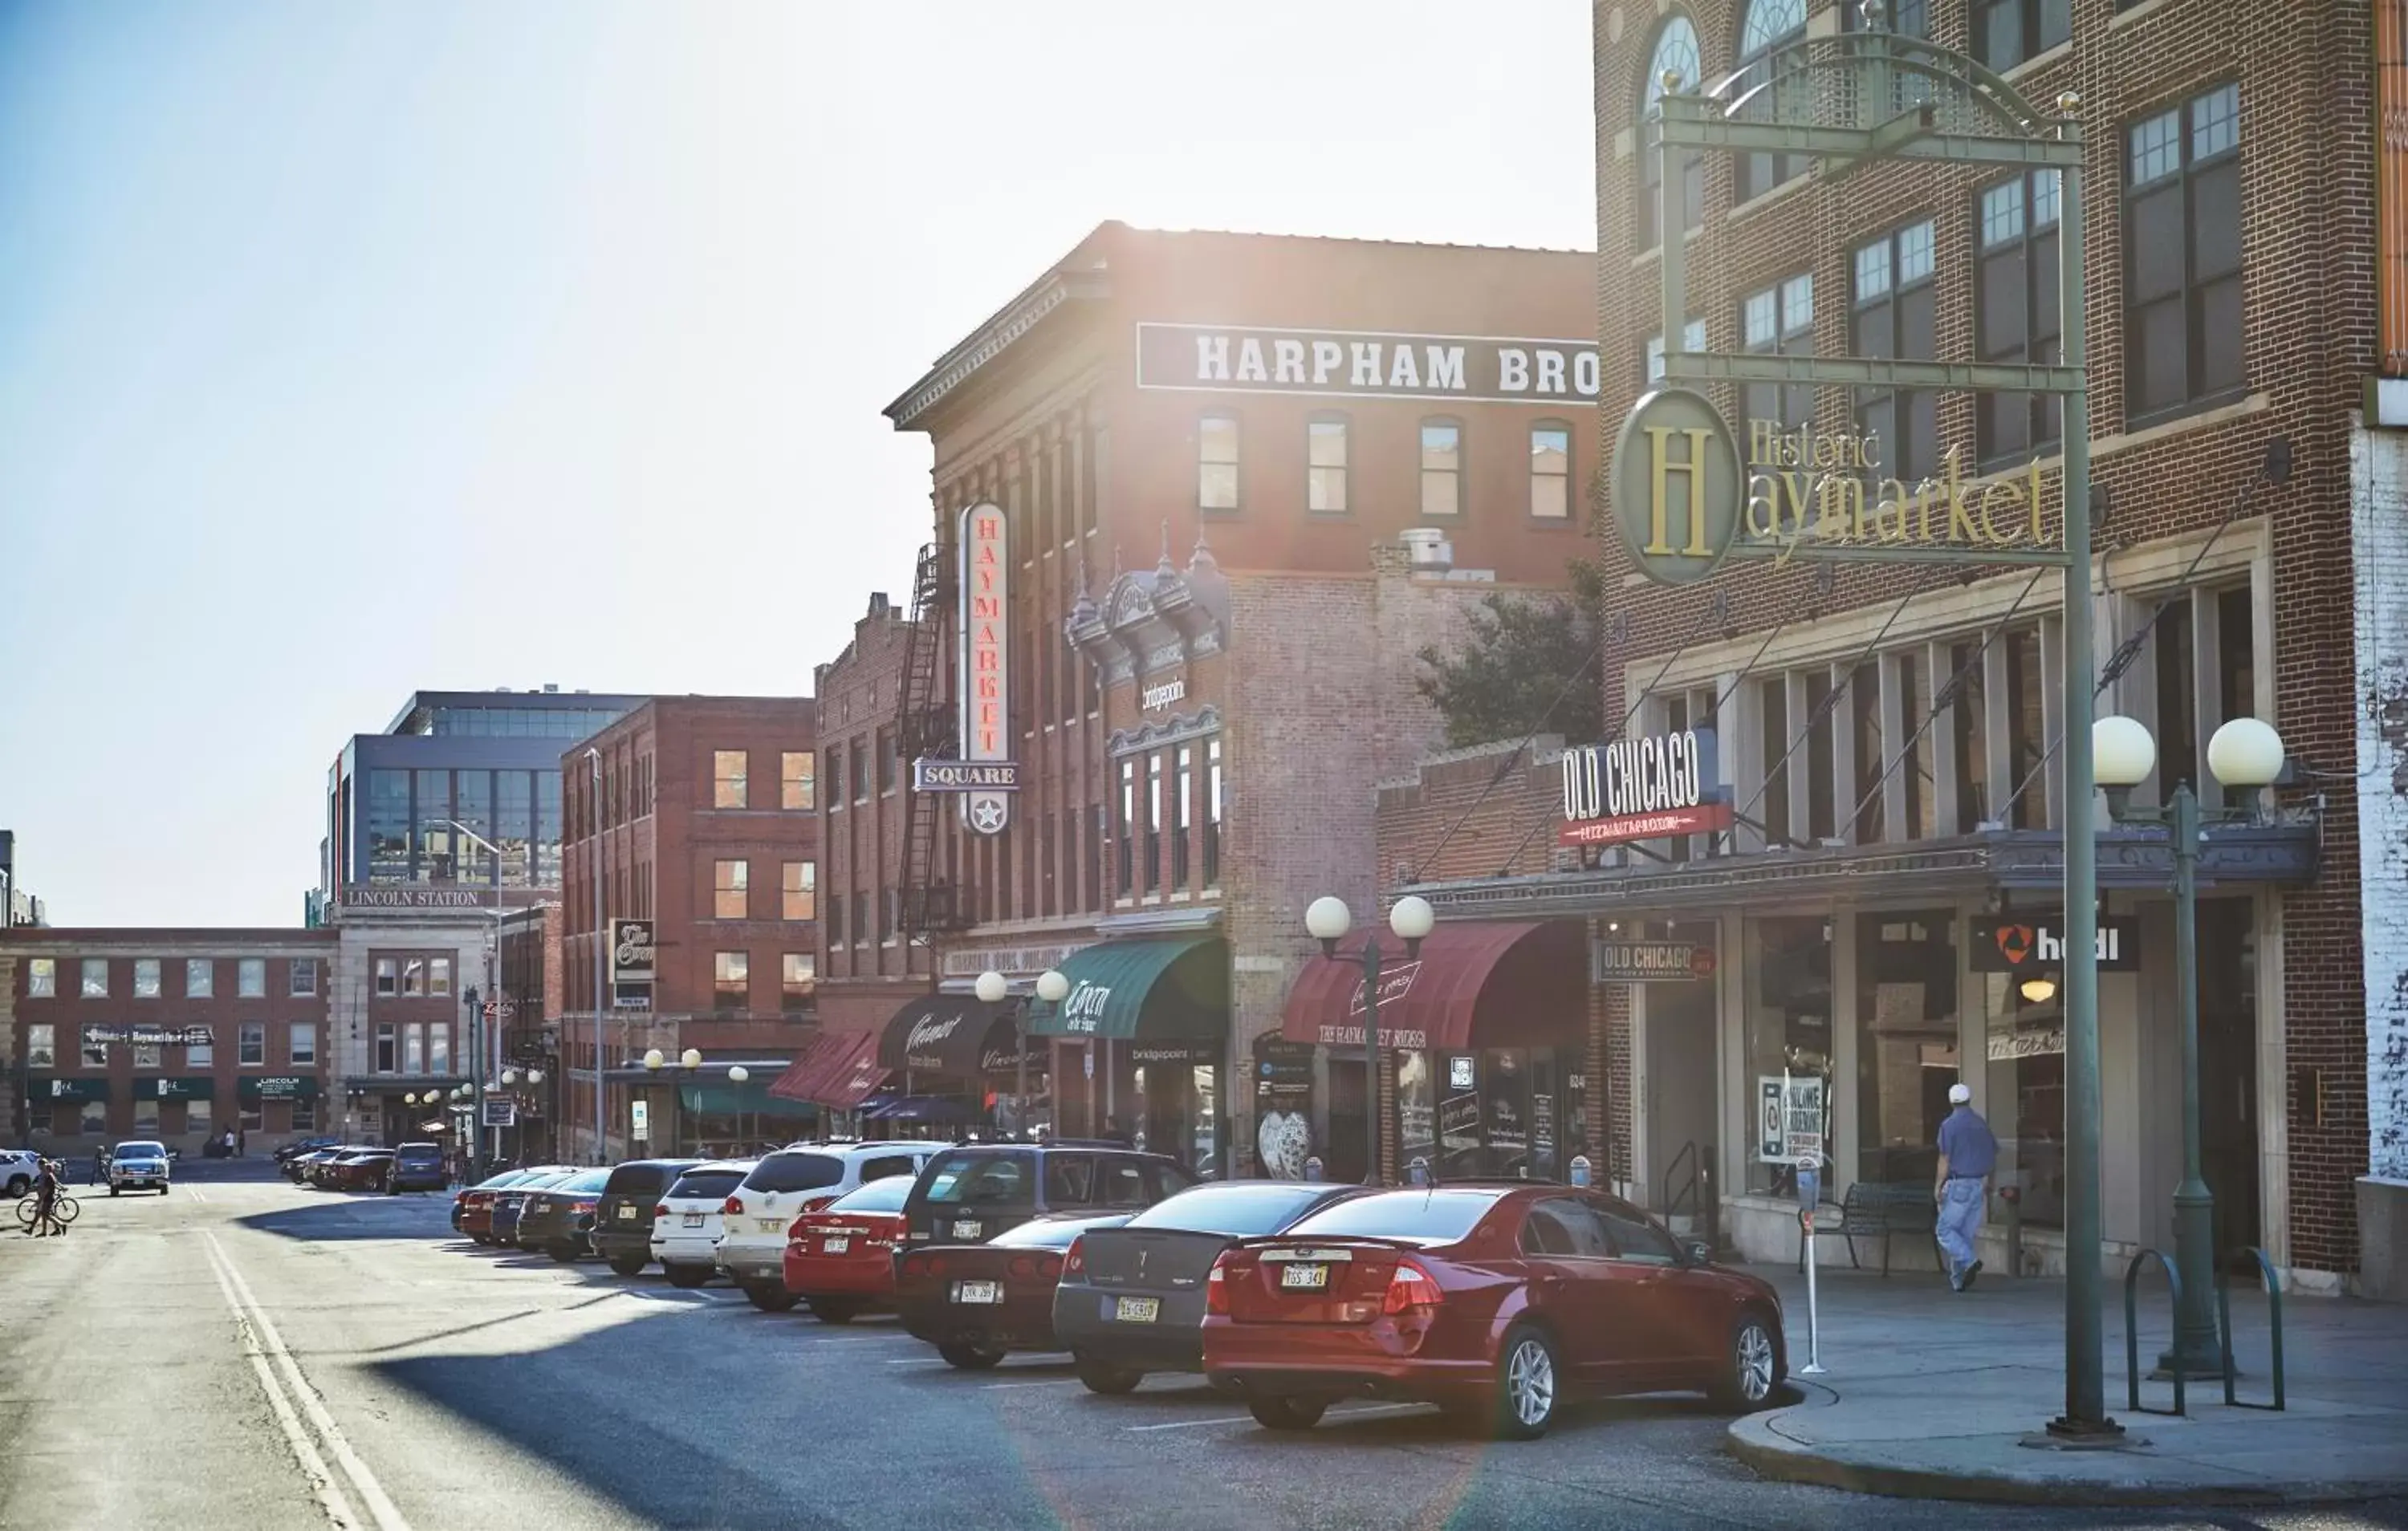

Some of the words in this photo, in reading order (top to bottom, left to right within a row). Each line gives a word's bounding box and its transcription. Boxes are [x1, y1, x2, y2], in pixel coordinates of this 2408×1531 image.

[1196, 335, 1466, 390] HARPHAM
[1747, 418, 1881, 469] Historic
[973, 516, 1000, 753] HAYMARKET
[924, 766, 1015, 786] SQUARE
[1563, 747, 1600, 822] OLD
[1606, 730, 1700, 817] CHICAGO
[348, 891, 413, 907] LINCOLN
[417, 891, 478, 906] STATION
[1605, 946, 1630, 969] OLD
[1633, 946, 1691, 969] CHICAGO
[2038, 927, 2119, 960] hdl
[1336, 1025, 1391, 1046] HAYMAET
[1133, 1049, 1187, 1060] bridgepoint
